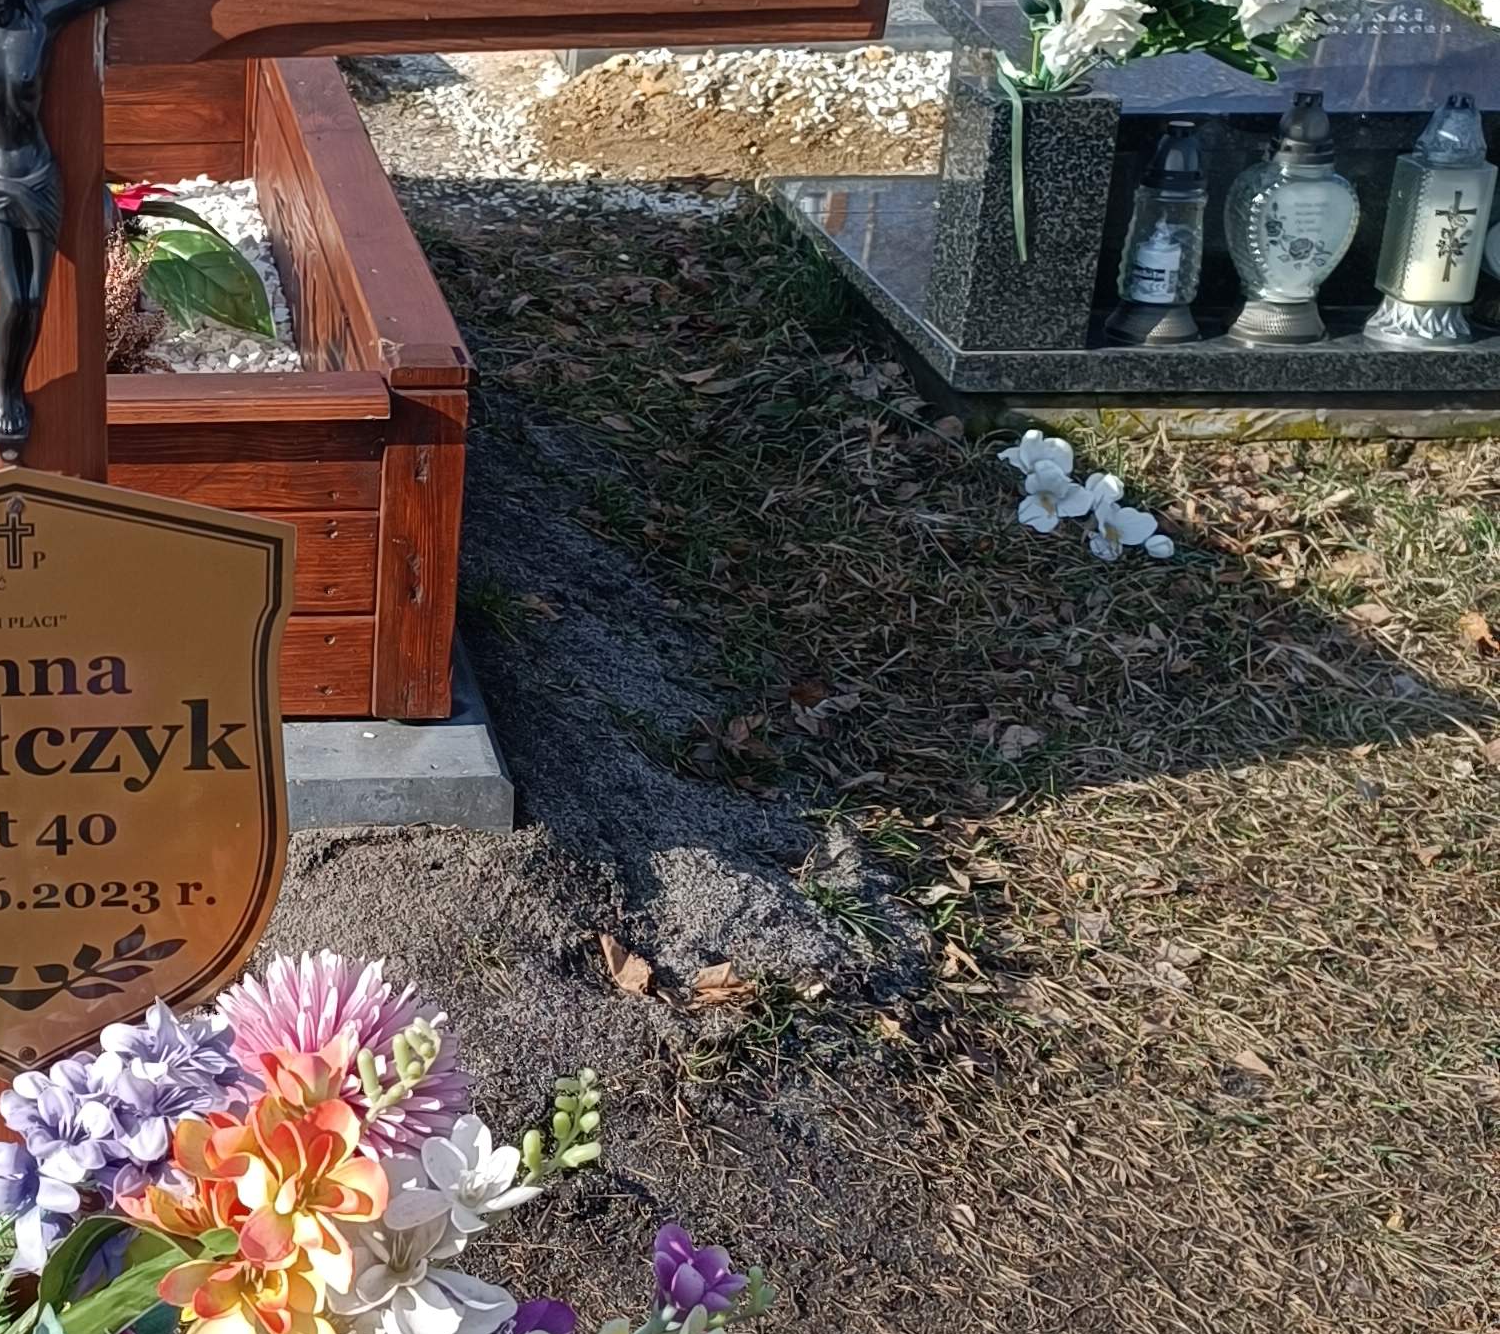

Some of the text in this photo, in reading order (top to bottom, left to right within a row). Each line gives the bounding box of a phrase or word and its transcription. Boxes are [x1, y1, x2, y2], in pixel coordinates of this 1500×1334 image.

[32, 551, 46, 570] P
[35, 812, 117, 856] 40
[177, 880, 216, 906] r.
